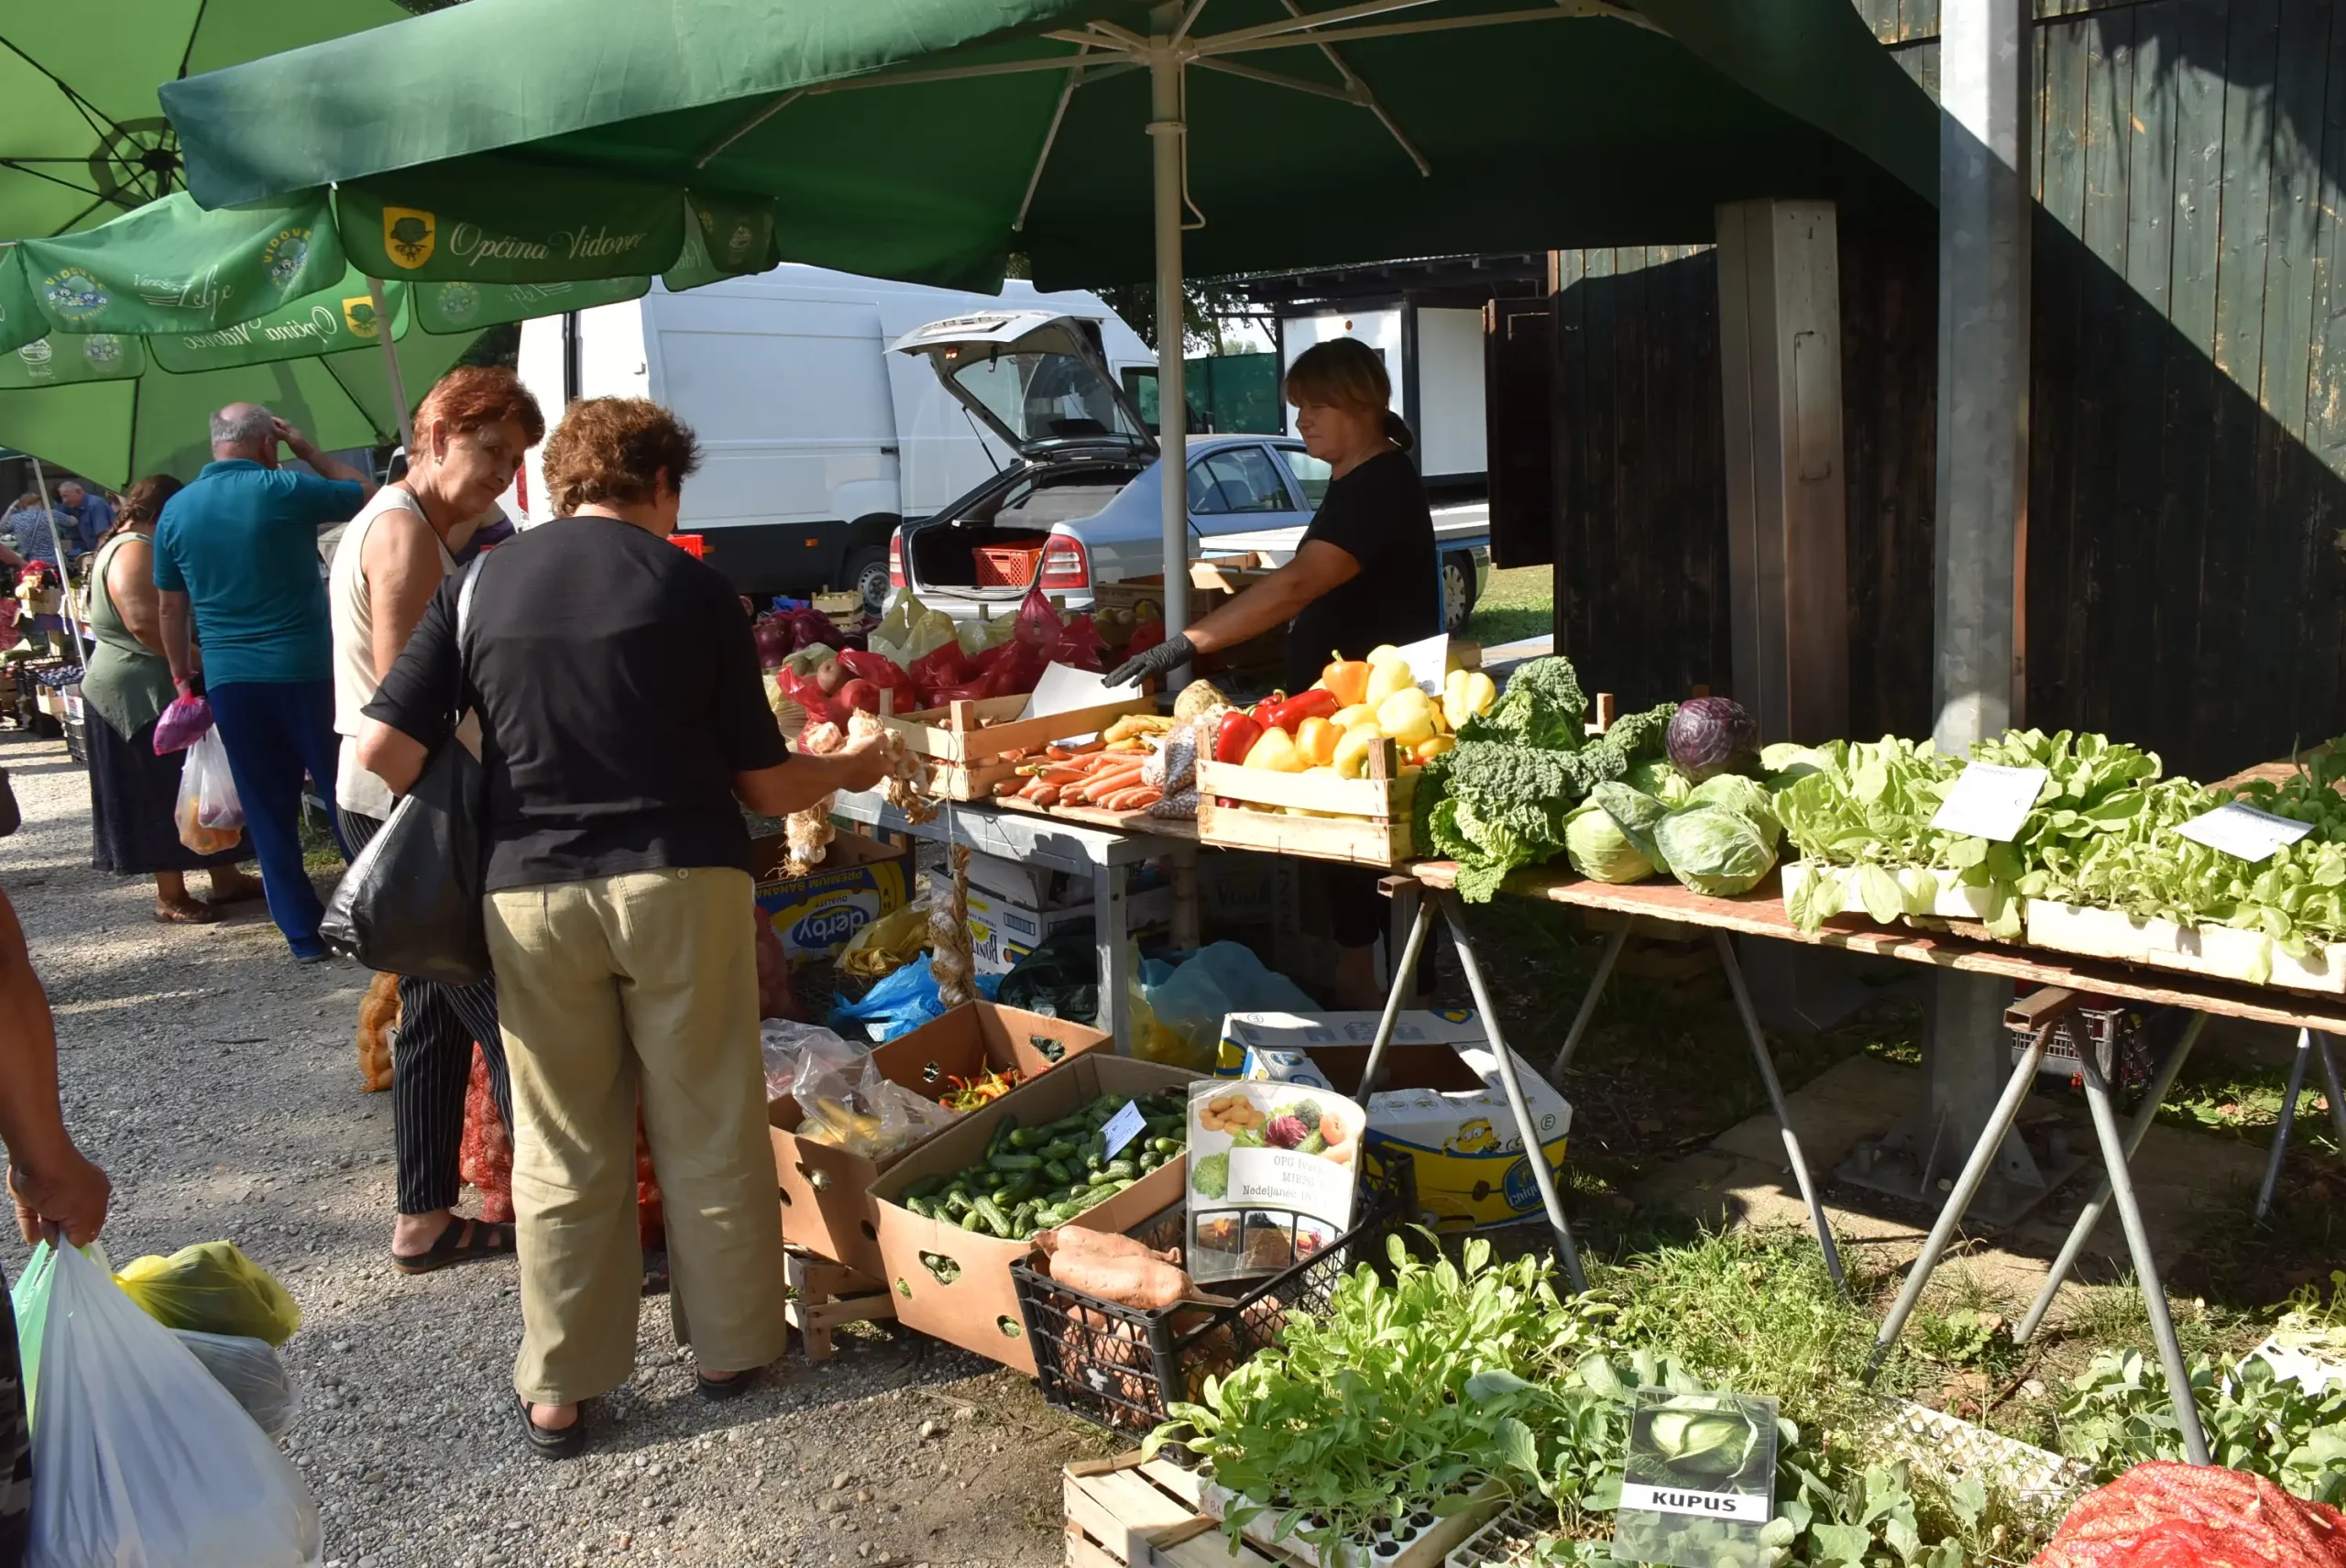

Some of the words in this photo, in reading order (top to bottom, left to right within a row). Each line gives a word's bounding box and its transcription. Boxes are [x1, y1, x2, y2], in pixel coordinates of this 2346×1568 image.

[450, 222, 550, 267] Općina
[807, 870, 863, 890] PREMIUM
[816, 894, 848, 908] QUALITY
[798, 911, 864, 942] derby
[1274, 1156, 1294, 1168] OPG
[1243, 1185, 1297, 1199] Nedeljanec
[1508, 1179, 1540, 1206] Chiqu
[1652, 1491, 1737, 1512] KUPUS
